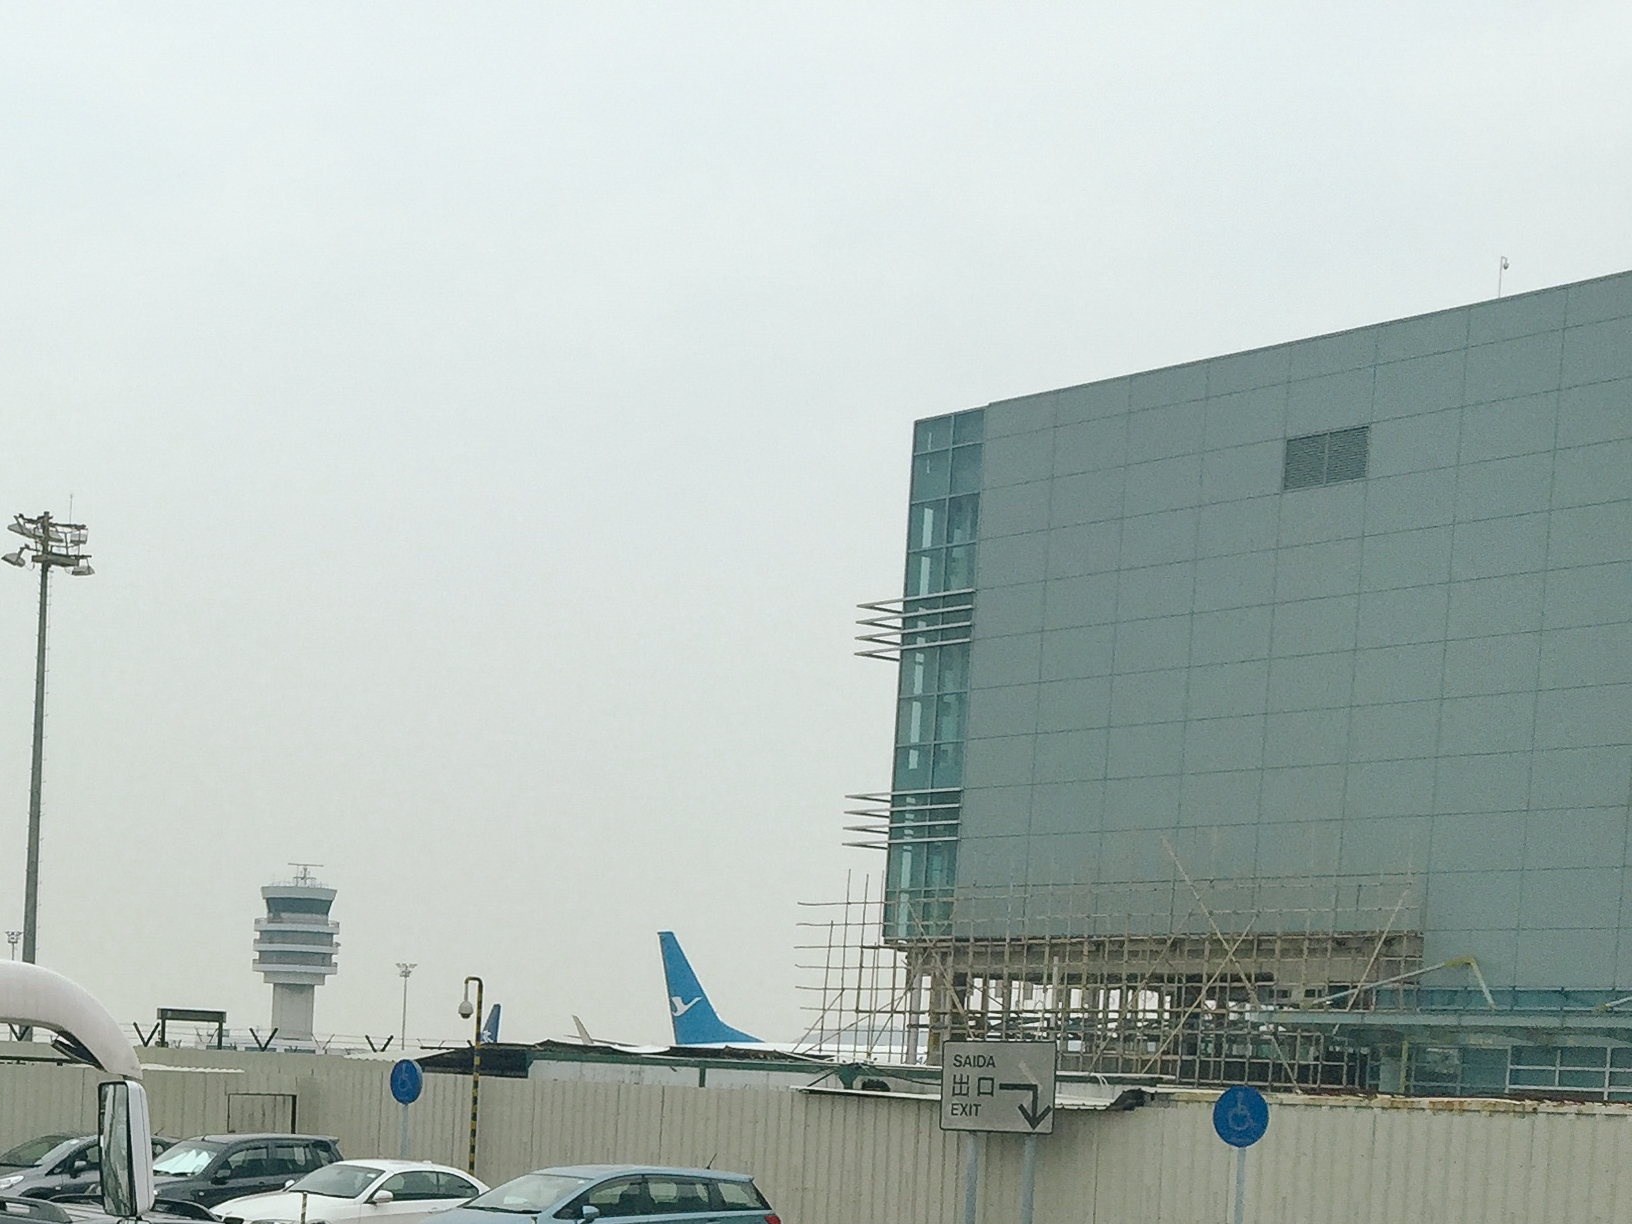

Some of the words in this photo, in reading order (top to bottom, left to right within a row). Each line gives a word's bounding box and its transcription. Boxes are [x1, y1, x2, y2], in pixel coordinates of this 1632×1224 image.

[952, 1053, 997, 1069] SAIDA
[951, 1073, 996, 1098] 出口
[950, 1102, 982, 1117] EXIT
